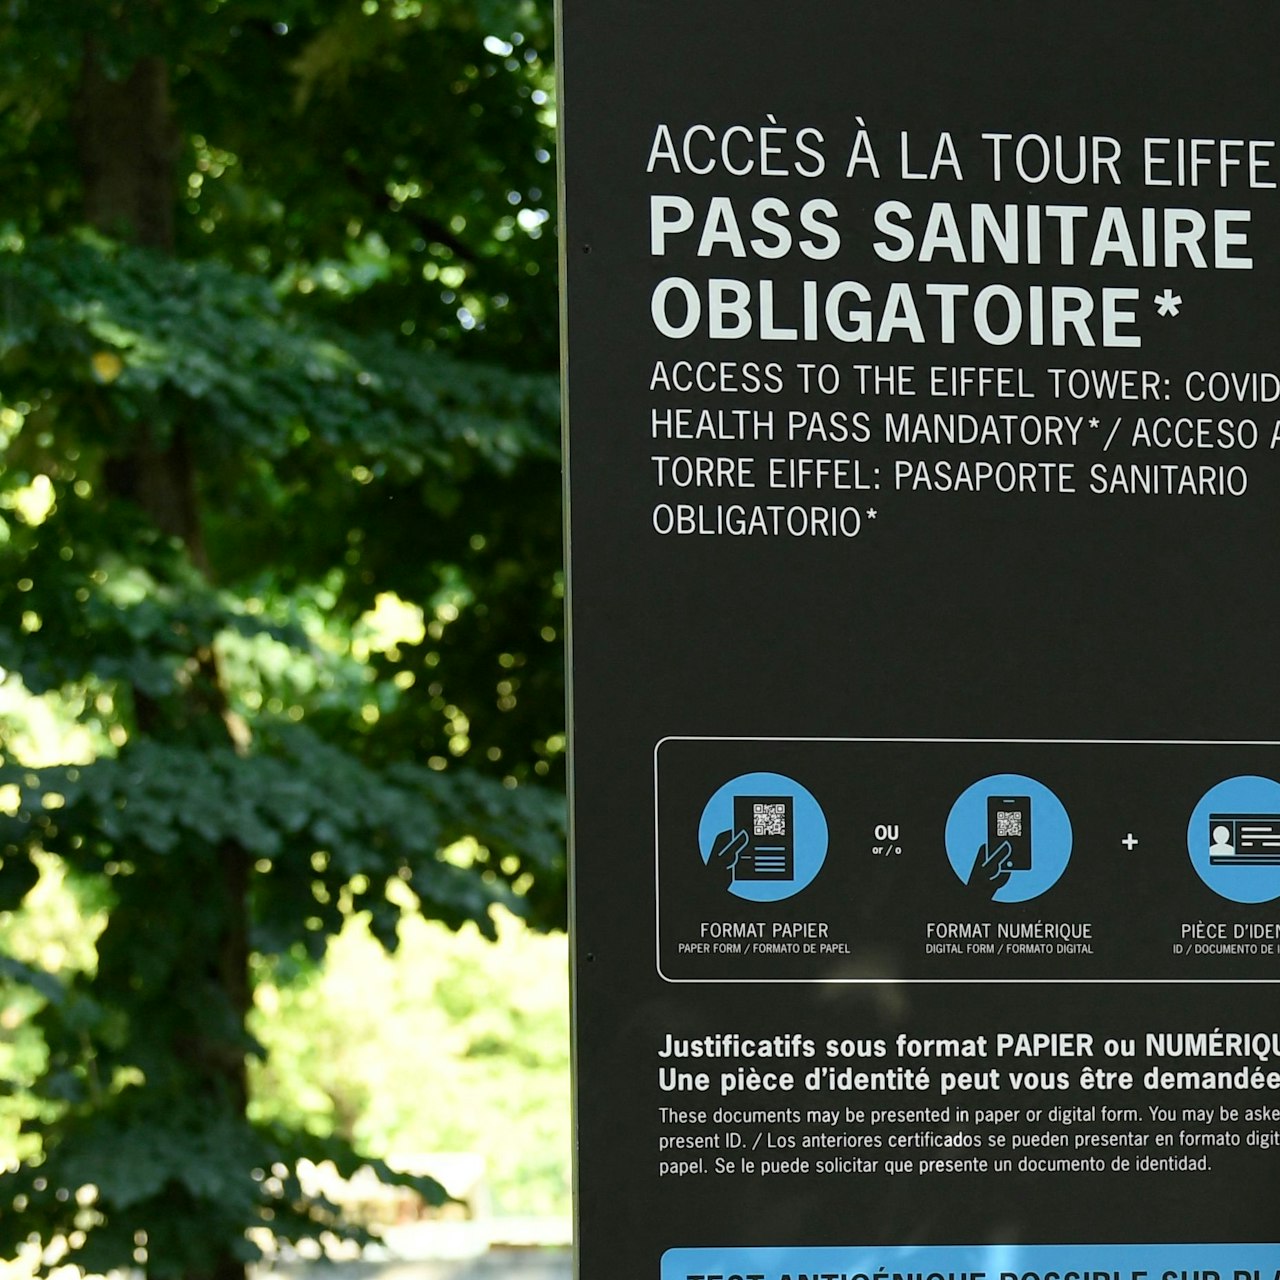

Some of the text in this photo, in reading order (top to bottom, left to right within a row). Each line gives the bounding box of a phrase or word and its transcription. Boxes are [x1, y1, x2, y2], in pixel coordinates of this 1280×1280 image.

[646, 114, 825, 177] ACCÈS
[846, 116, 880, 178] À
[901, 131, 963, 180] LA
[981, 133, 1121, 185] TOUR
[650, 195, 1253, 269] PASS SANITAIRE
[650, 361, 783, 393] ACCESS
[796, 364, 839, 394] TO
[853, 365, 916, 395] THE
[931, 366, 1035, 398] EIFFEL
[1047, 369, 1170, 400] TOWER:
[652, 408, 773, 440] HEALTH
[789, 411, 870, 442] PASS
[1132, 417, 1258, 449] ACCESO
[651, 456, 1247, 496] TORRE EIFFEL: PASAPORTE SANITARIO
[874, 825, 899, 841] OU
[885, 844, 893, 856] /
[701, 922, 828, 938] FORMAT PAPIER
[927, 920, 1092, 941] FORMAT NUMÉRIQUE
[1182, 920, 1227, 939] PIÈCE
[678, 943, 851, 955] PAPER FORM / FORMATO DE PAPEL
[926, 943, 1094, 955] DIGITAL FORM / FORMATO DIGITAL
[1173, 944, 1183, 954] ID
[1185, 944, 1192, 955] /
[1195, 944, 1258, 954] DOCUMENTO
[1261, 944, 1274, 954] DE
[658, 1034, 815, 1058] Justificatifs
[826, 1039, 886, 1057] sous
[896, 1034, 987, 1057] format
[997, 1033, 1094, 1057] PAPIER
[1104, 1039, 1135, 1057] ou
[659, 1067, 710, 1091] Une
[721, 1067, 794, 1096] pièce
[941, 1069, 1000, 1095] peut
[1009, 1072, 1070, 1090] vous
[1080, 1066, 1133, 1090] être
[658, 1107, 707, 1123] These
[713, 1107, 801, 1123] documents
[807, 1110, 840, 1126] may
[846, 1107, 865, 1123] be
[871, 1106, 950, 1125] presented
[956, 1106, 969, 1122] in
[975, 1110, 1020, 1125] paper
[1026, 1110, 1043, 1122] or
[1048, 1106, 1095, 1125] digital
[1101, 1105, 1142, 1122] form.
[1148, 1106, 1176, 1121] You
[1182, 1109, 1214, 1124] may
[1220, 1105, 1239, 1121] be
